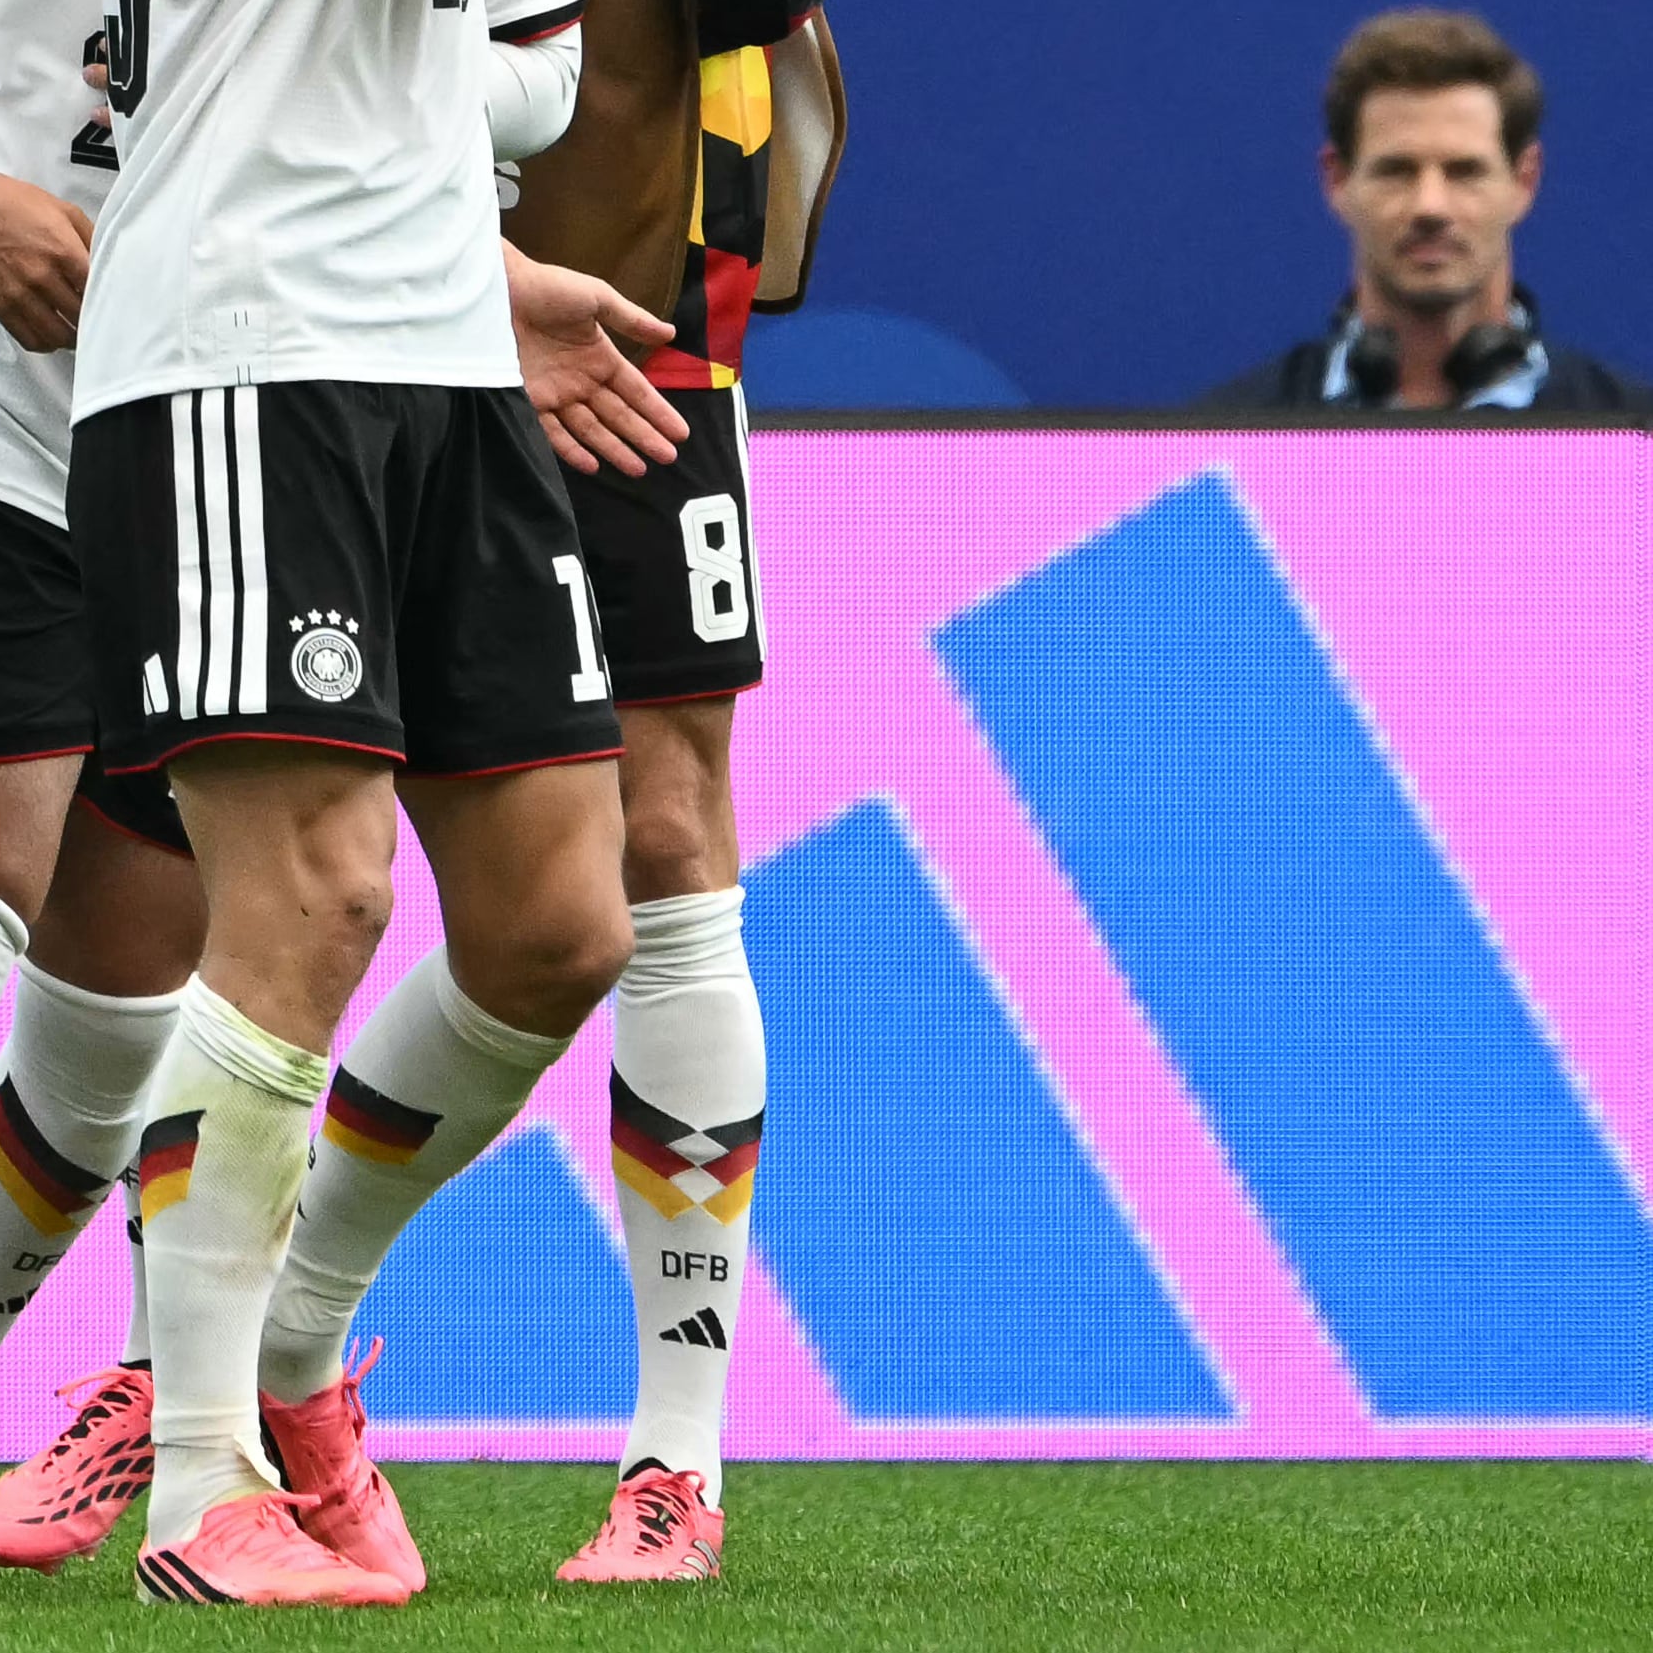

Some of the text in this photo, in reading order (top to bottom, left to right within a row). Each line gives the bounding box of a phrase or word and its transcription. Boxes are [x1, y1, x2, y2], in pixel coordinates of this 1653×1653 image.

[552, 554, 613, 702] 1
[679, 493, 749, 643] 8
[660, 1250, 729, 1282] DFB
